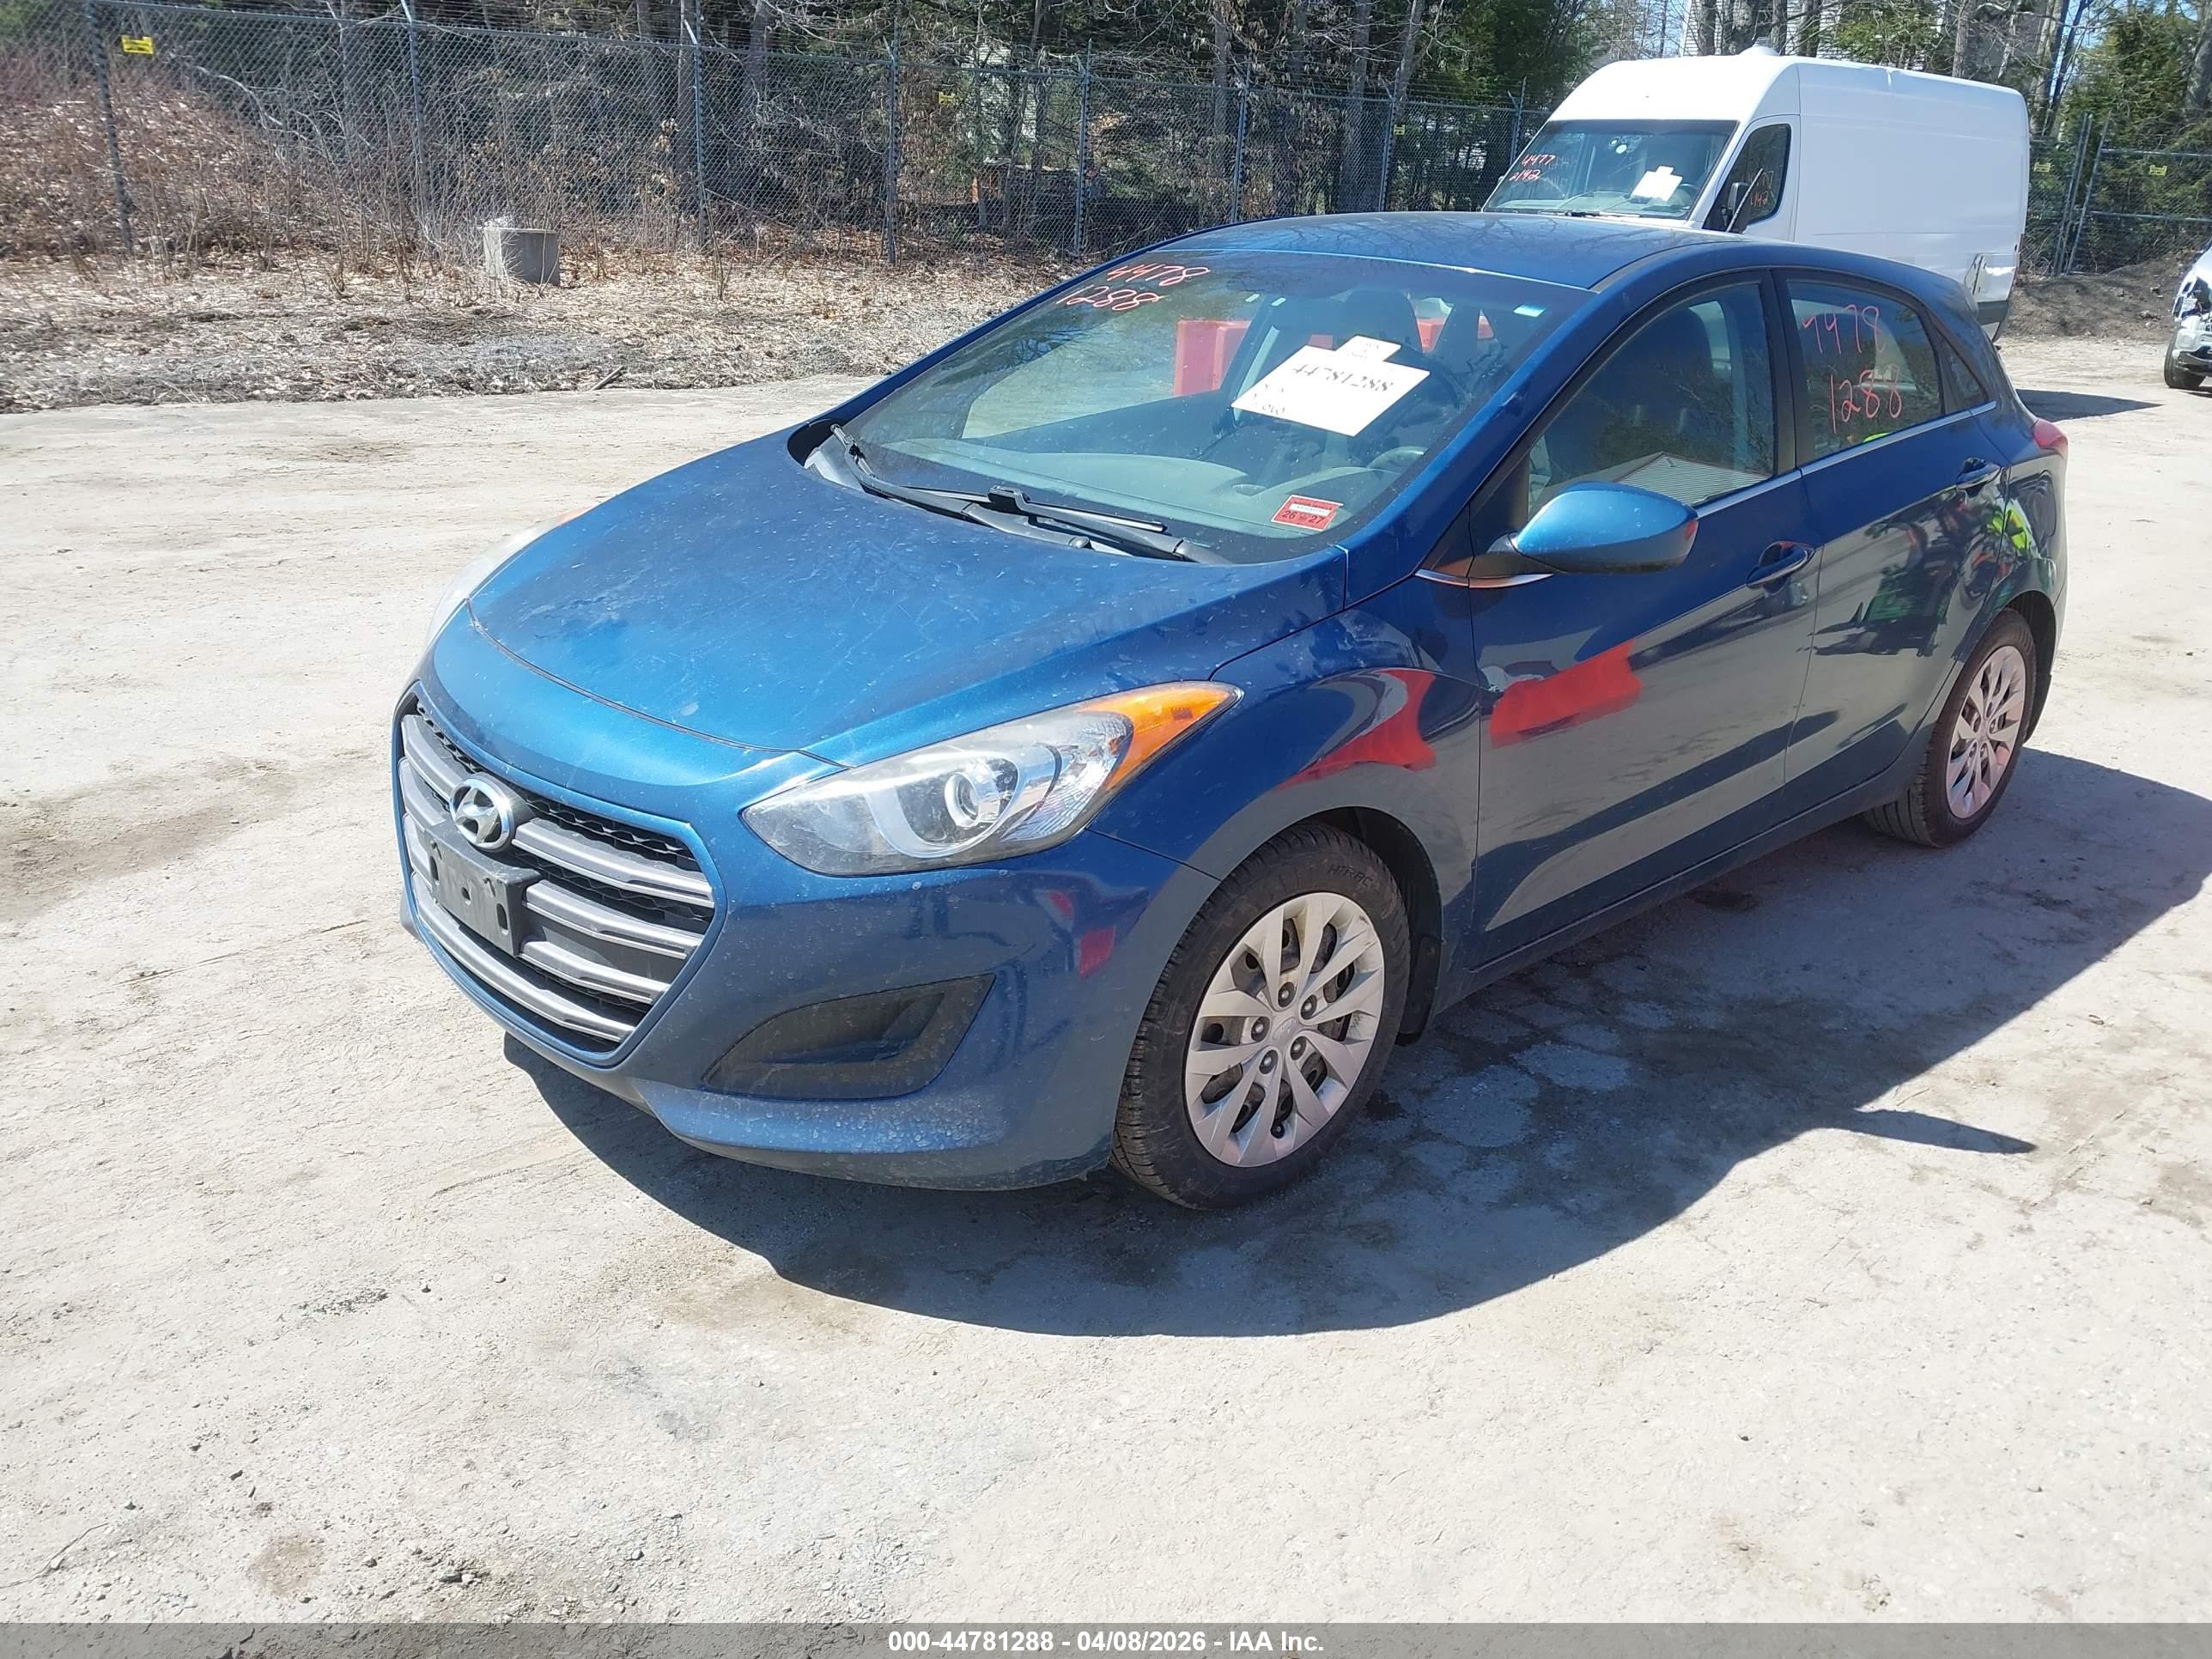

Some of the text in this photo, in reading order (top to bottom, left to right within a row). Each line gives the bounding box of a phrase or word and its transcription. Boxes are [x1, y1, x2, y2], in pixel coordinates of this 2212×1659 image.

[1522, 154, 1556, 167] 4477
[1106, 263, 1211, 287] 4478
[1055, 283, 1164, 311] 1288
[1829, 363, 1903, 434] 1288
[1282, 510, 1297, 520] 26
[1308, 515, 1326, 525] 27
